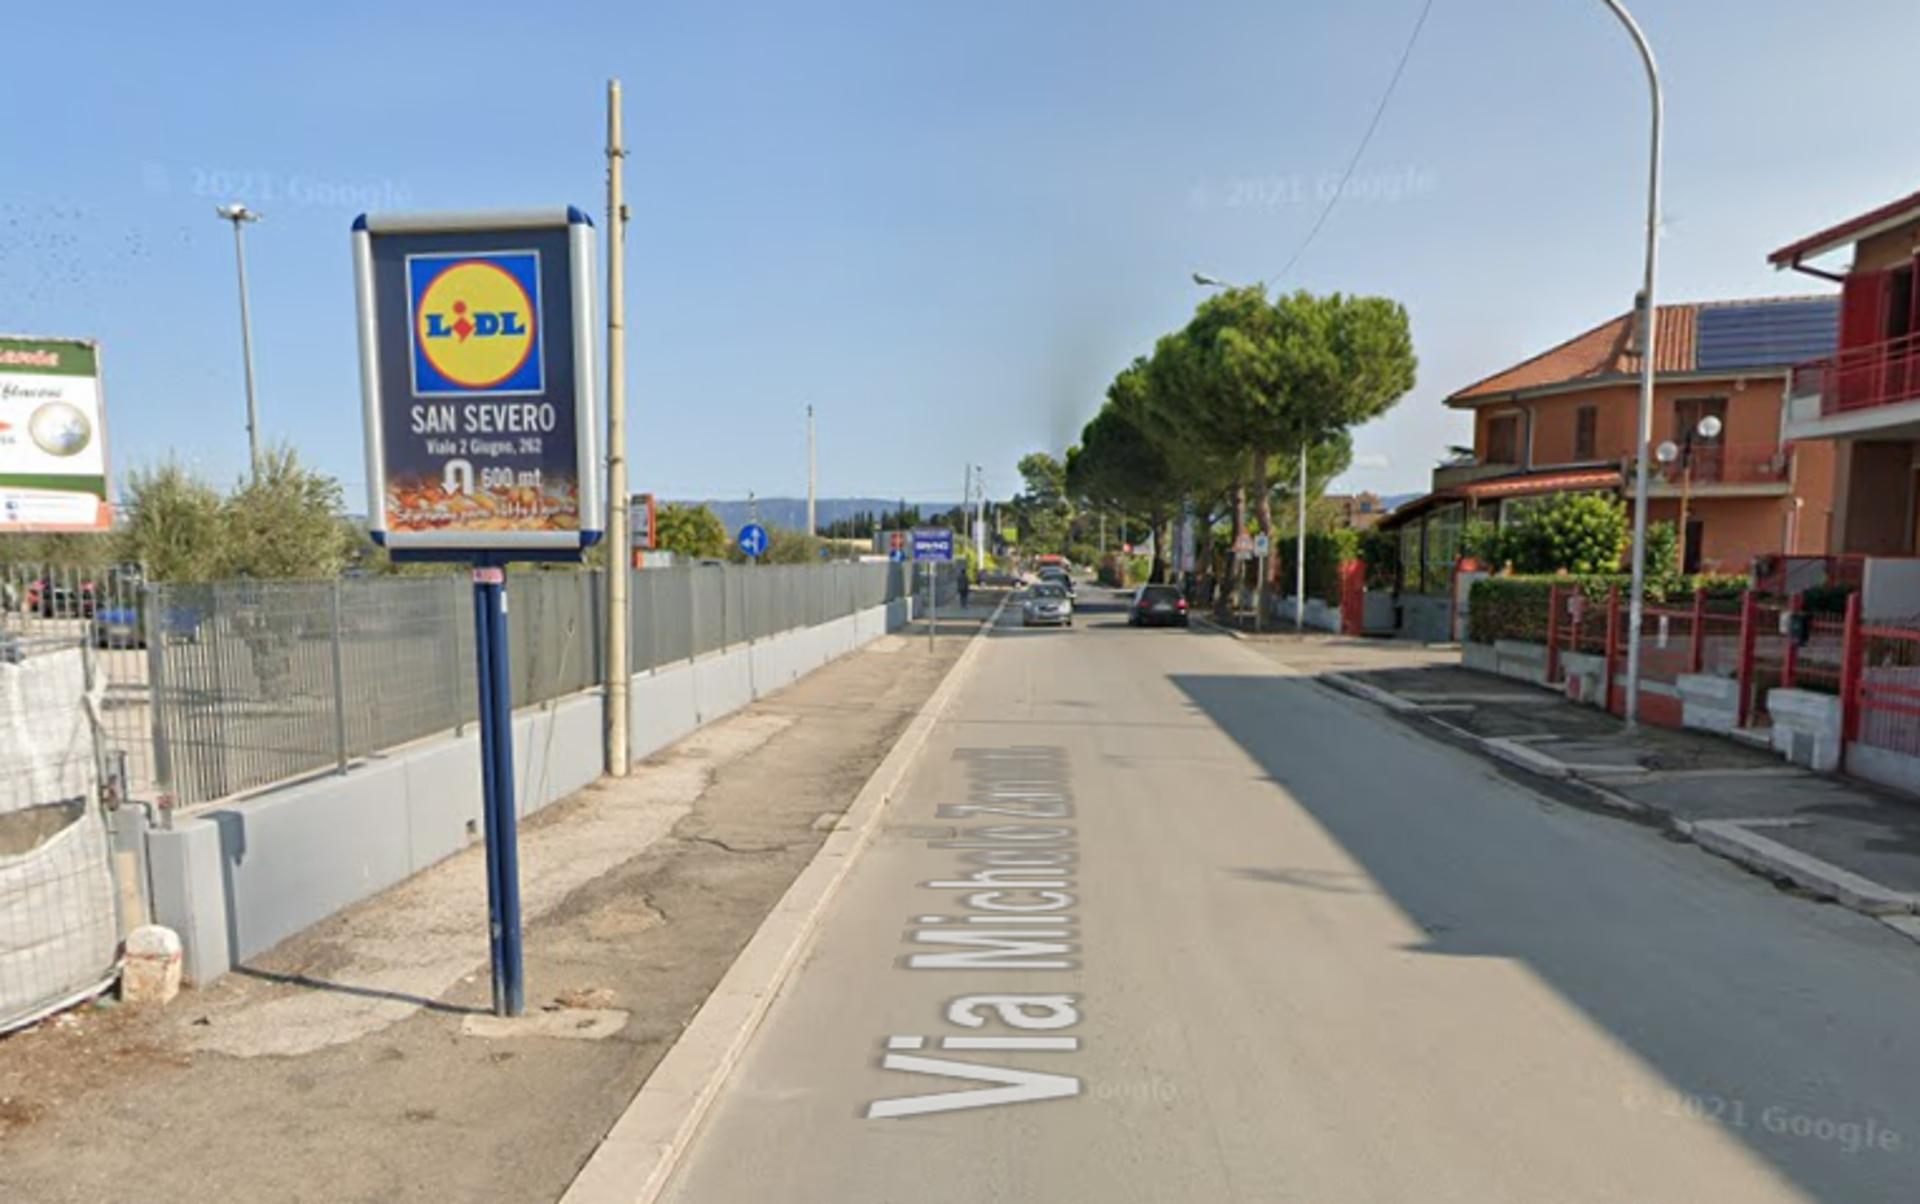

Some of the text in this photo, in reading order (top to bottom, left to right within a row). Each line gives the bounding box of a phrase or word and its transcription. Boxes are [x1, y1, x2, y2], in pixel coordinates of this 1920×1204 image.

[411, 402, 557, 434] SAN SEVERO
[426, 438, 457, 455] Viale
[459, 438, 468, 454] 2
